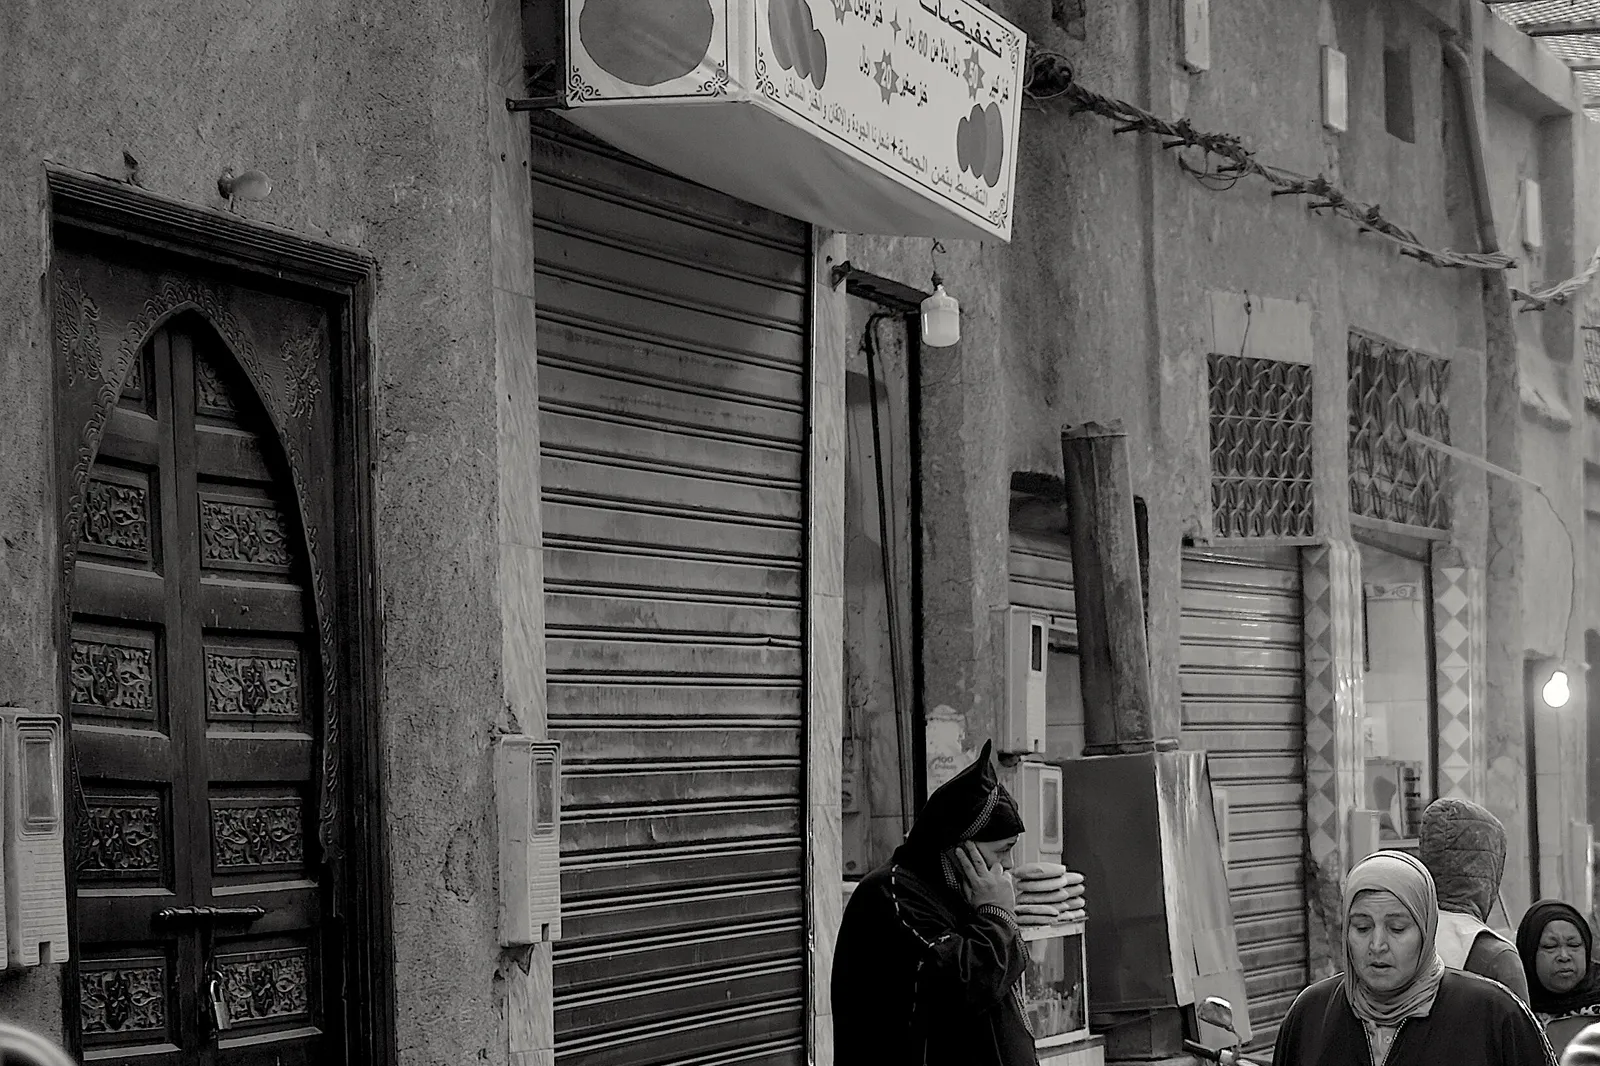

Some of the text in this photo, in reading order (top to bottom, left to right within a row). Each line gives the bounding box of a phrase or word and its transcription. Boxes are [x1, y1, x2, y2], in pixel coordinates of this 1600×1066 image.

[918, 30, 928, 57] 60
[880, 61, 892, 90] 20
[969, 61, 979, 89] 50
[898, 138, 928, 175] الجملة
[955, 173, 989, 207] التقسيط
